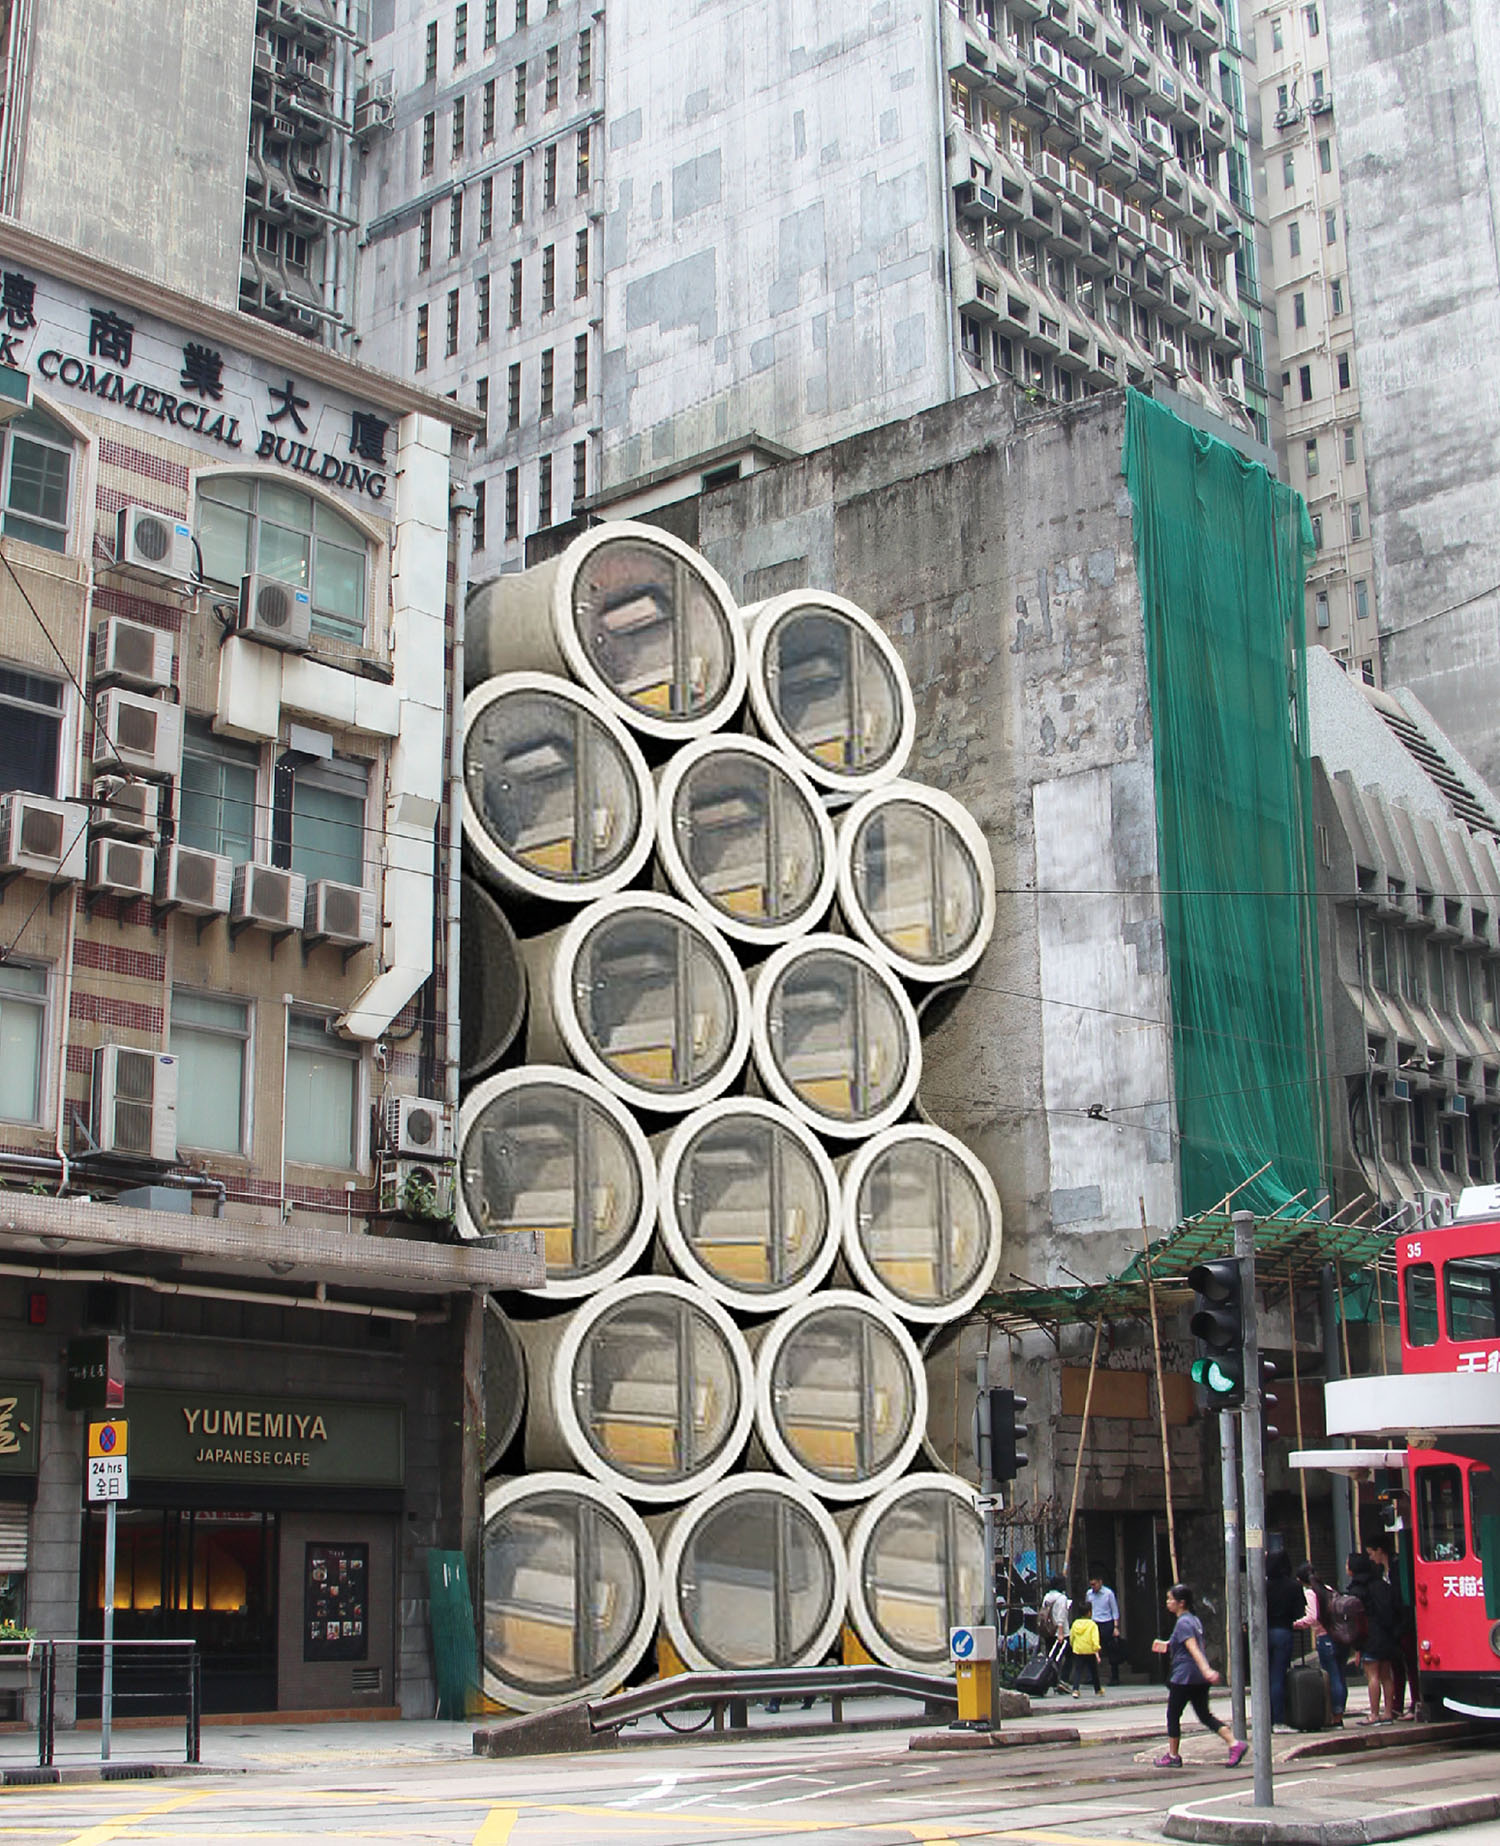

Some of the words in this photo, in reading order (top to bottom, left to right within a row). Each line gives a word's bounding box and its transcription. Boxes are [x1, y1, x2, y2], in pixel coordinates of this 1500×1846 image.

[37, 349, 242, 448] COMMERCIAL
[255, 430, 387, 499] BUILDING
[1406, 1241, 1423, 1259] 35
[182, 1407, 328, 1441] YUMEMIYA
[196, 1447, 271, 1465] JAPANESE
[273, 1451, 310, 1467] CAFE
[92, 1462, 105, 1475] 24
[106, 1462, 123, 1474] hrs
[96, 1477, 120, 1497] 全日
